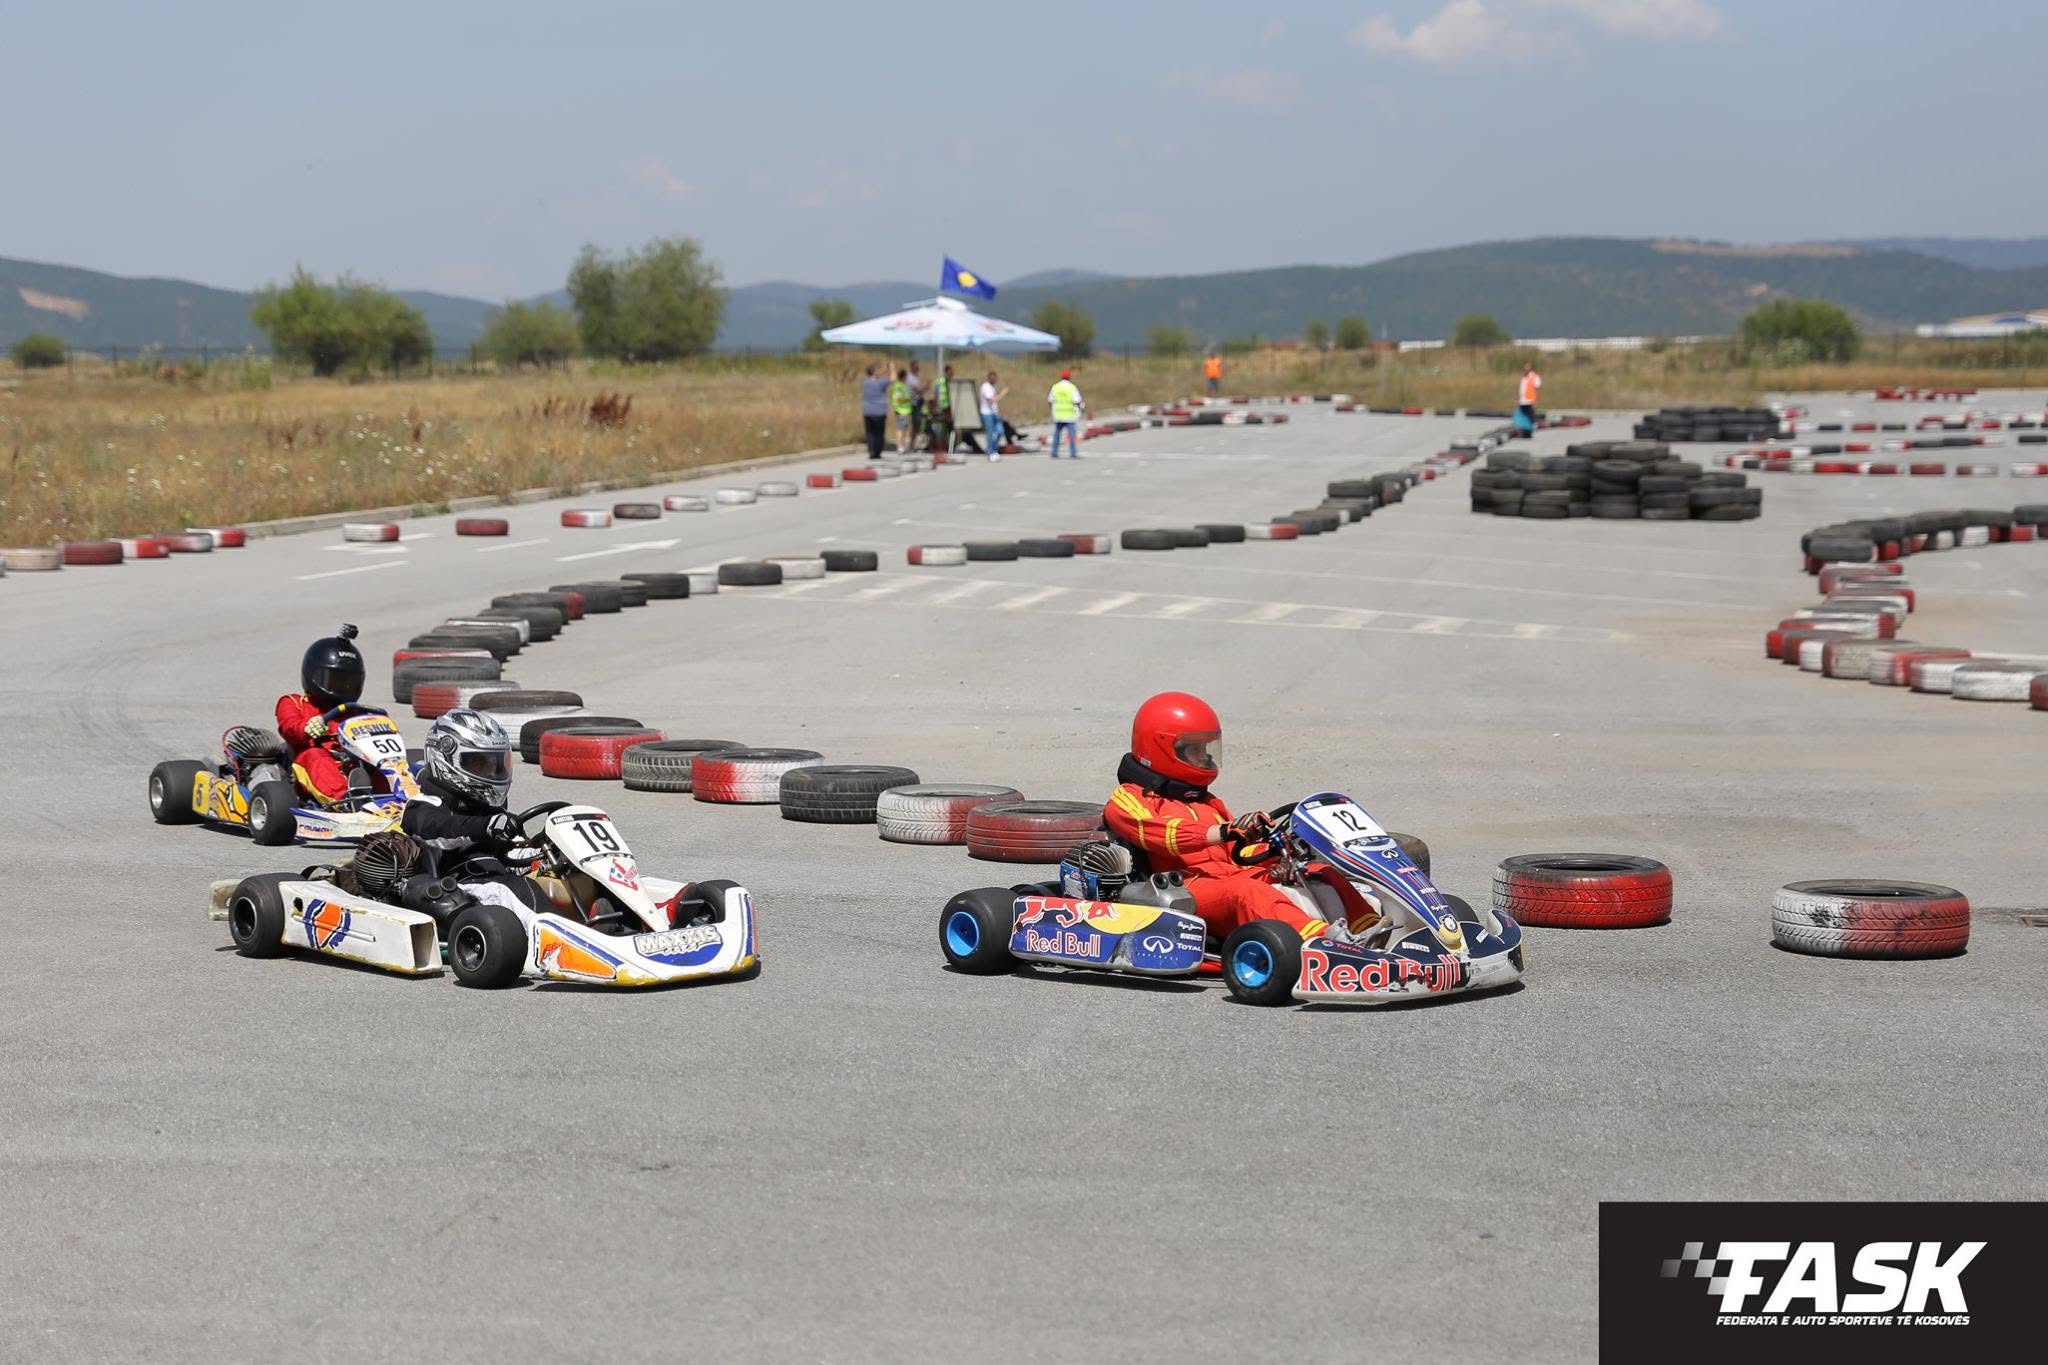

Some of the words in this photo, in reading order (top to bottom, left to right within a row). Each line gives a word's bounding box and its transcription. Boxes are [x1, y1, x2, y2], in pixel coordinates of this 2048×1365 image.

[350, 723, 391, 736] BESNIK
[373, 738, 402, 754] 50
[1332, 810, 1367, 832] 12
[573, 821, 620, 853] 19
[638, 927, 719, 952] MAXXIS
[1026, 929, 1062, 953] Red
[1065, 933, 1101, 958] Bull
[1176, 942, 1202, 951] TOTAL
[1301, 950, 1389, 992] Red
